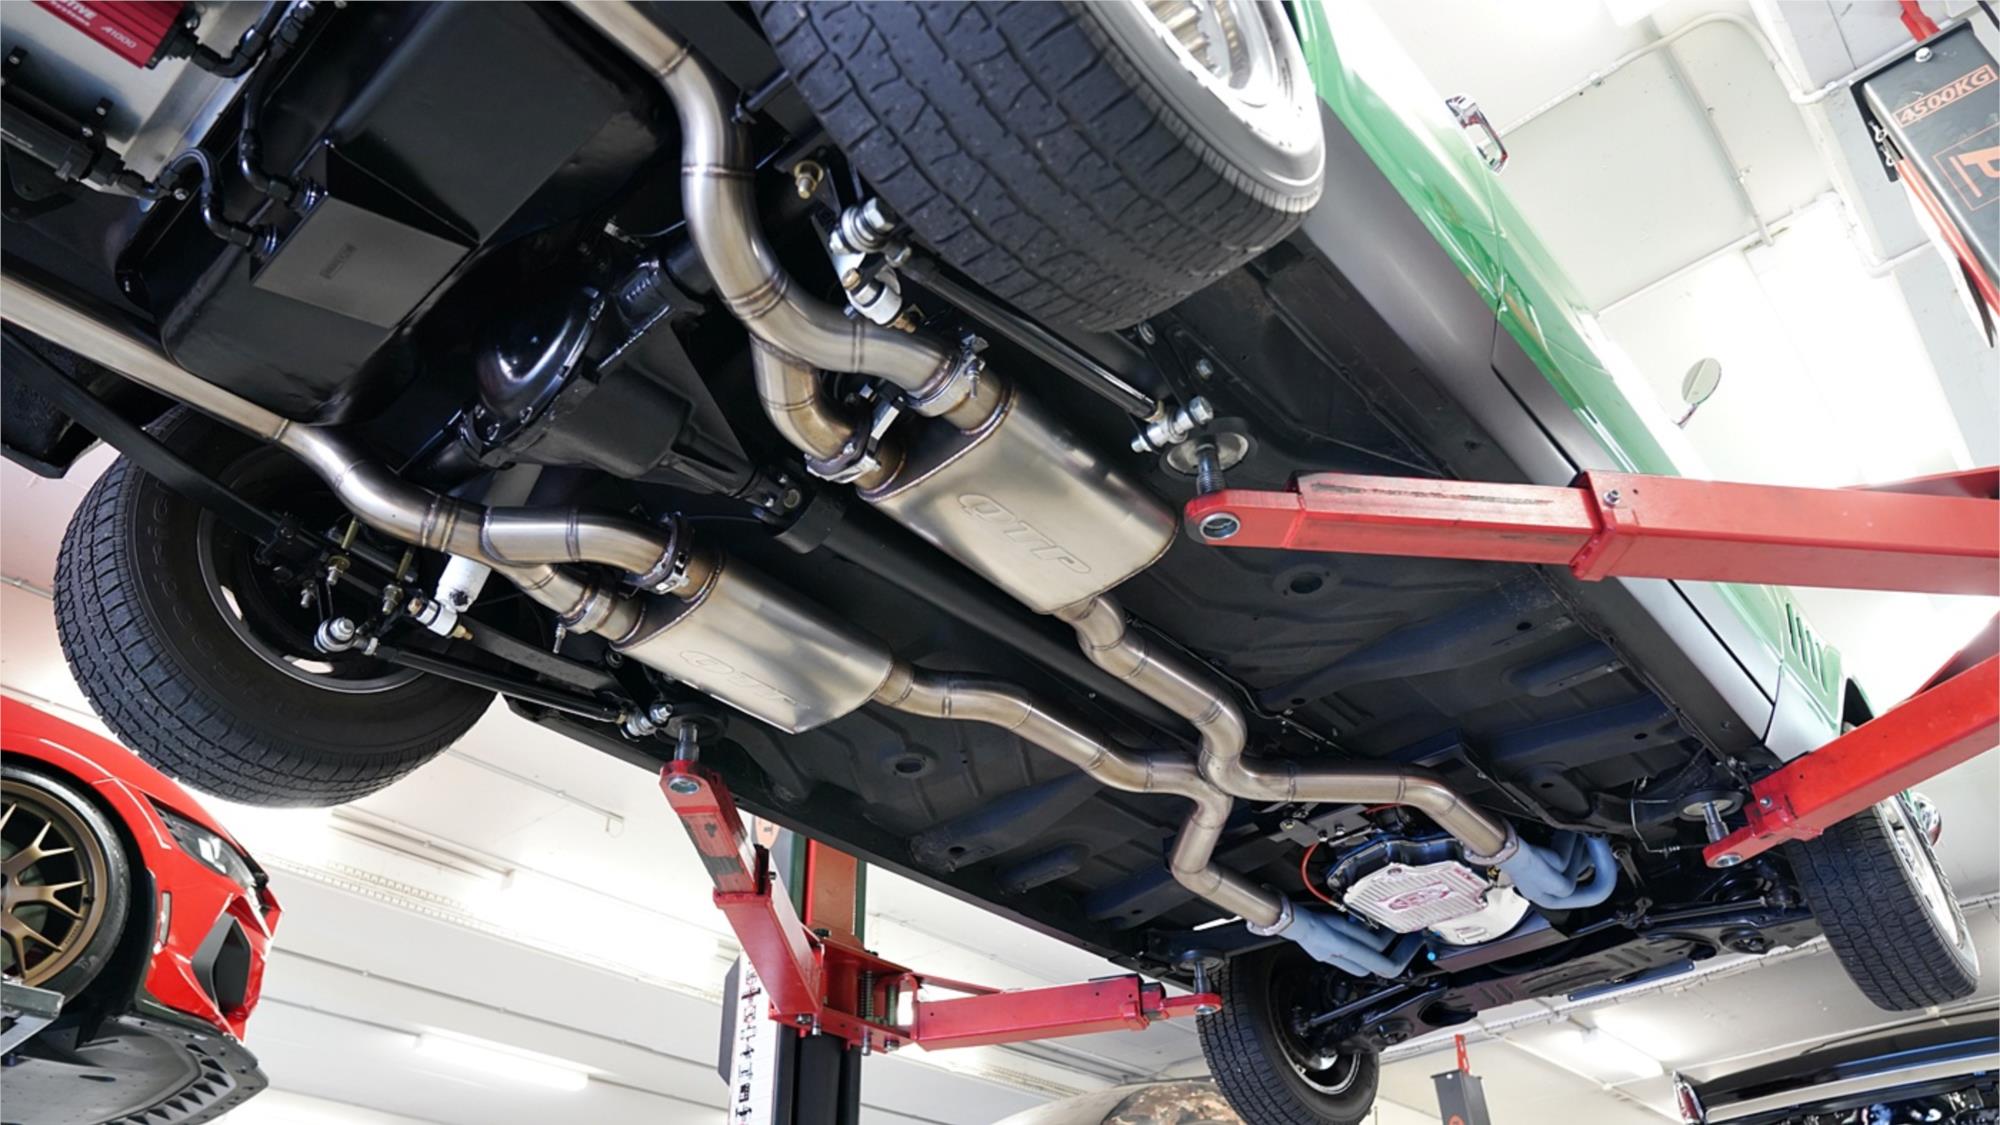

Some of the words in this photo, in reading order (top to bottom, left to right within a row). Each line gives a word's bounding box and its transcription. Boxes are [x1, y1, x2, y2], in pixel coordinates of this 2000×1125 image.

[101, 26, 137, 48] A1000
[1901, 69, 1990, 122] 4500KG
[957, 493, 1092, 574] QTP
